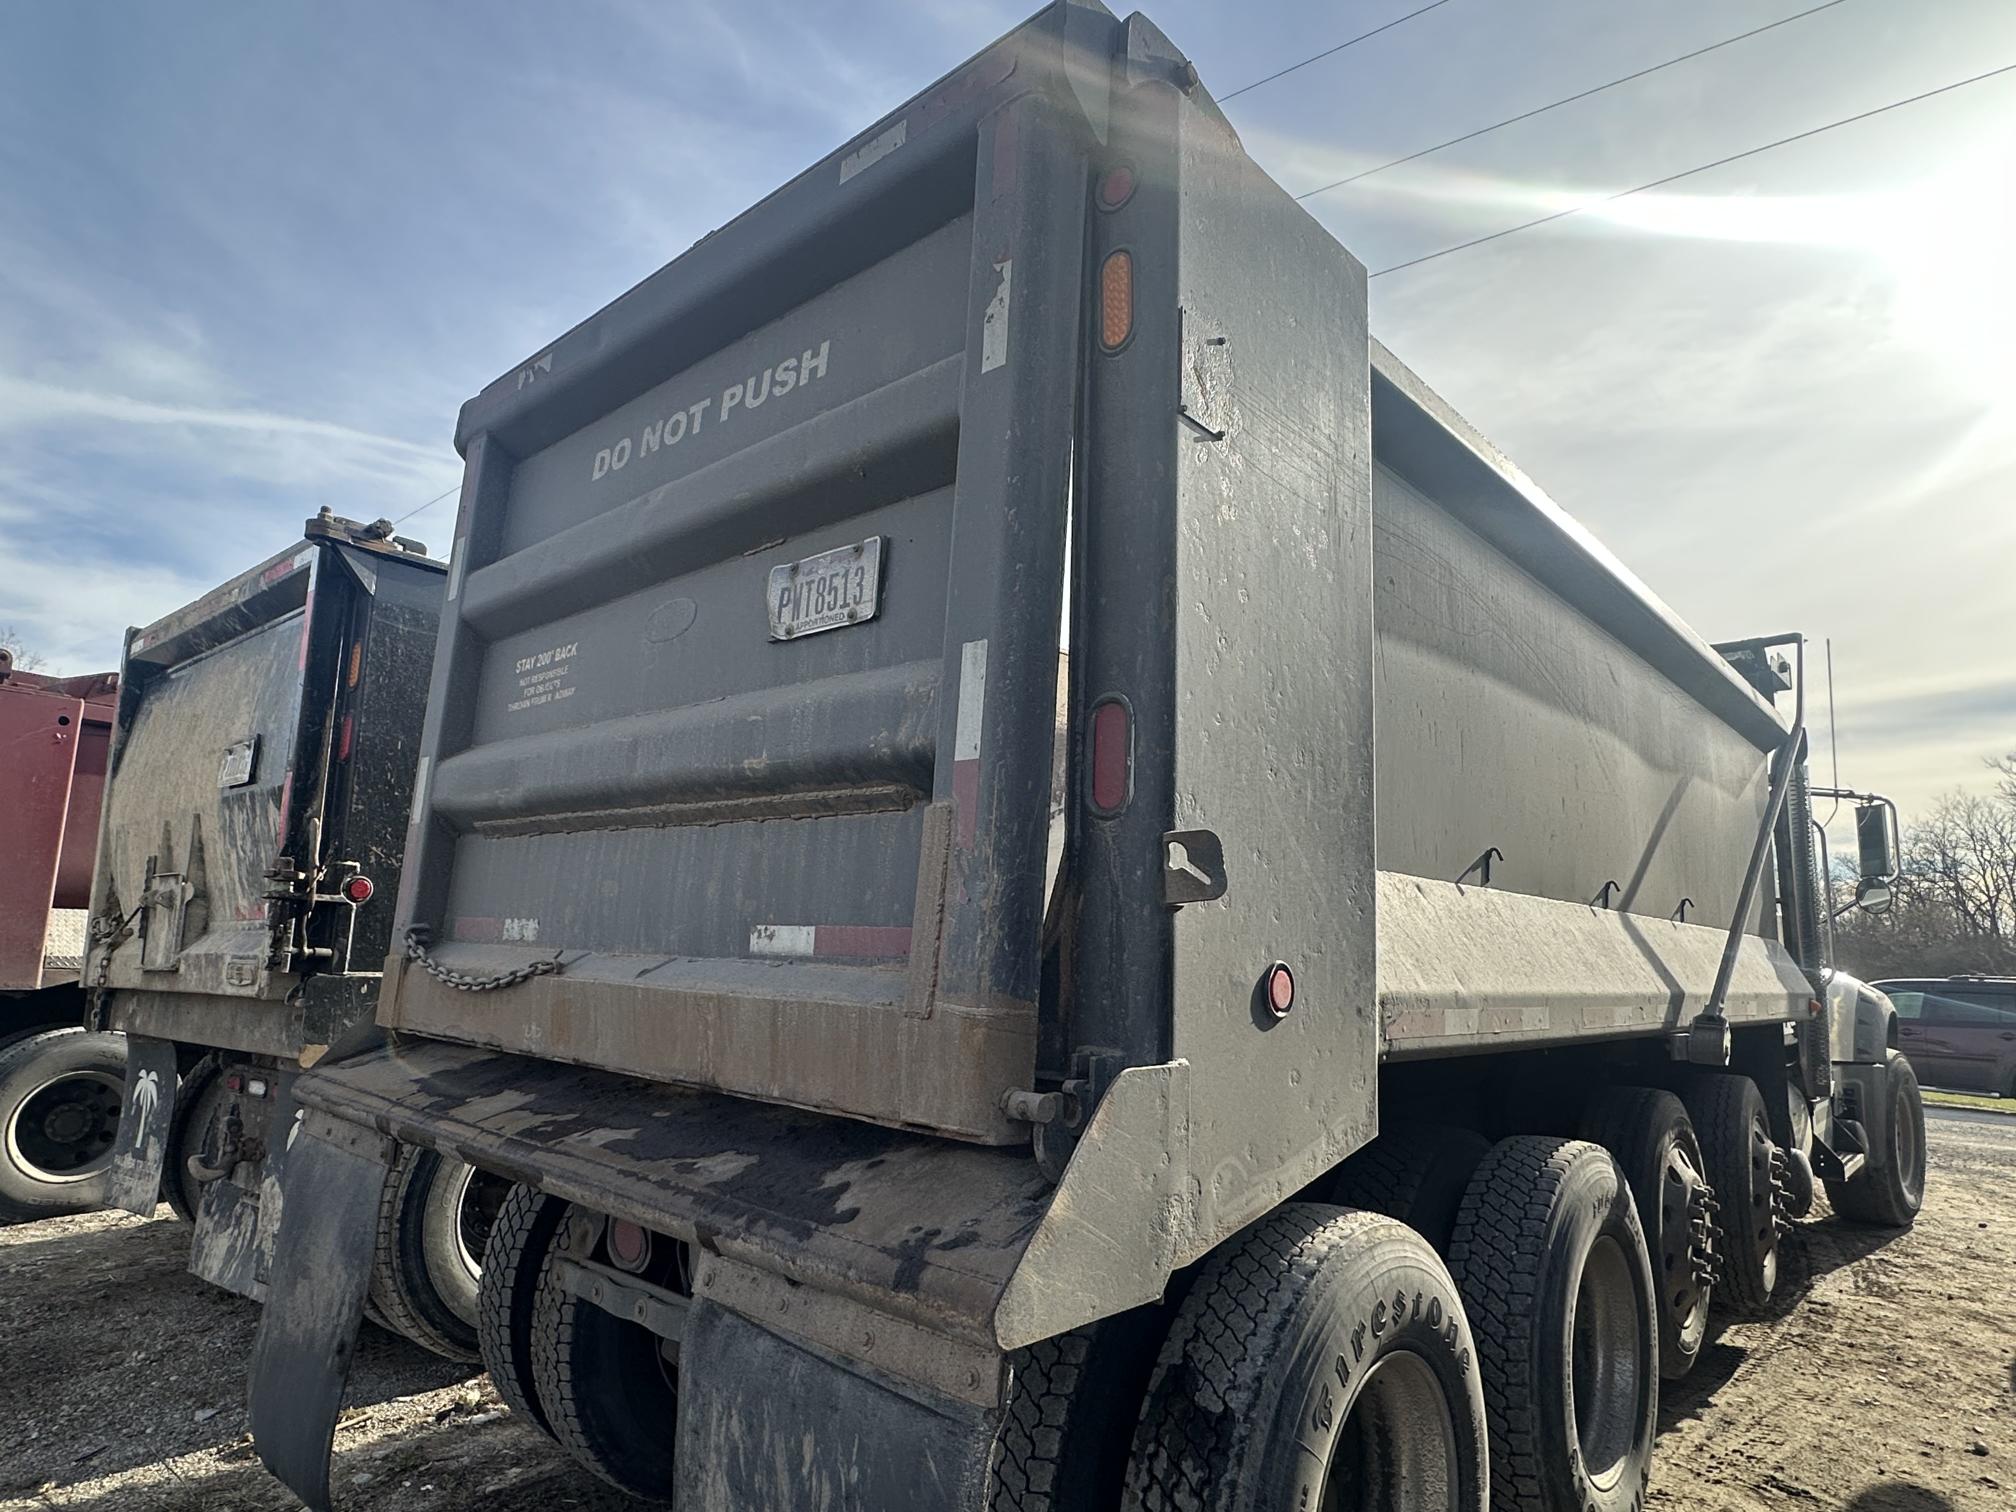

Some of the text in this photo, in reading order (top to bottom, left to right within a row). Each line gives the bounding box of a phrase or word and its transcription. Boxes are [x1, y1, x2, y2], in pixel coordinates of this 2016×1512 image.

[592, 340, 830, 482] DO NOT PUSH
[515, 655, 537, 674] STAY
[555, 641, 578, 661] BACK
[519, 664, 569, 687] NOT RESPONSIBLE
[523, 686, 535, 698] FOR
[1311, 1288, 1471, 1434] Firestone
